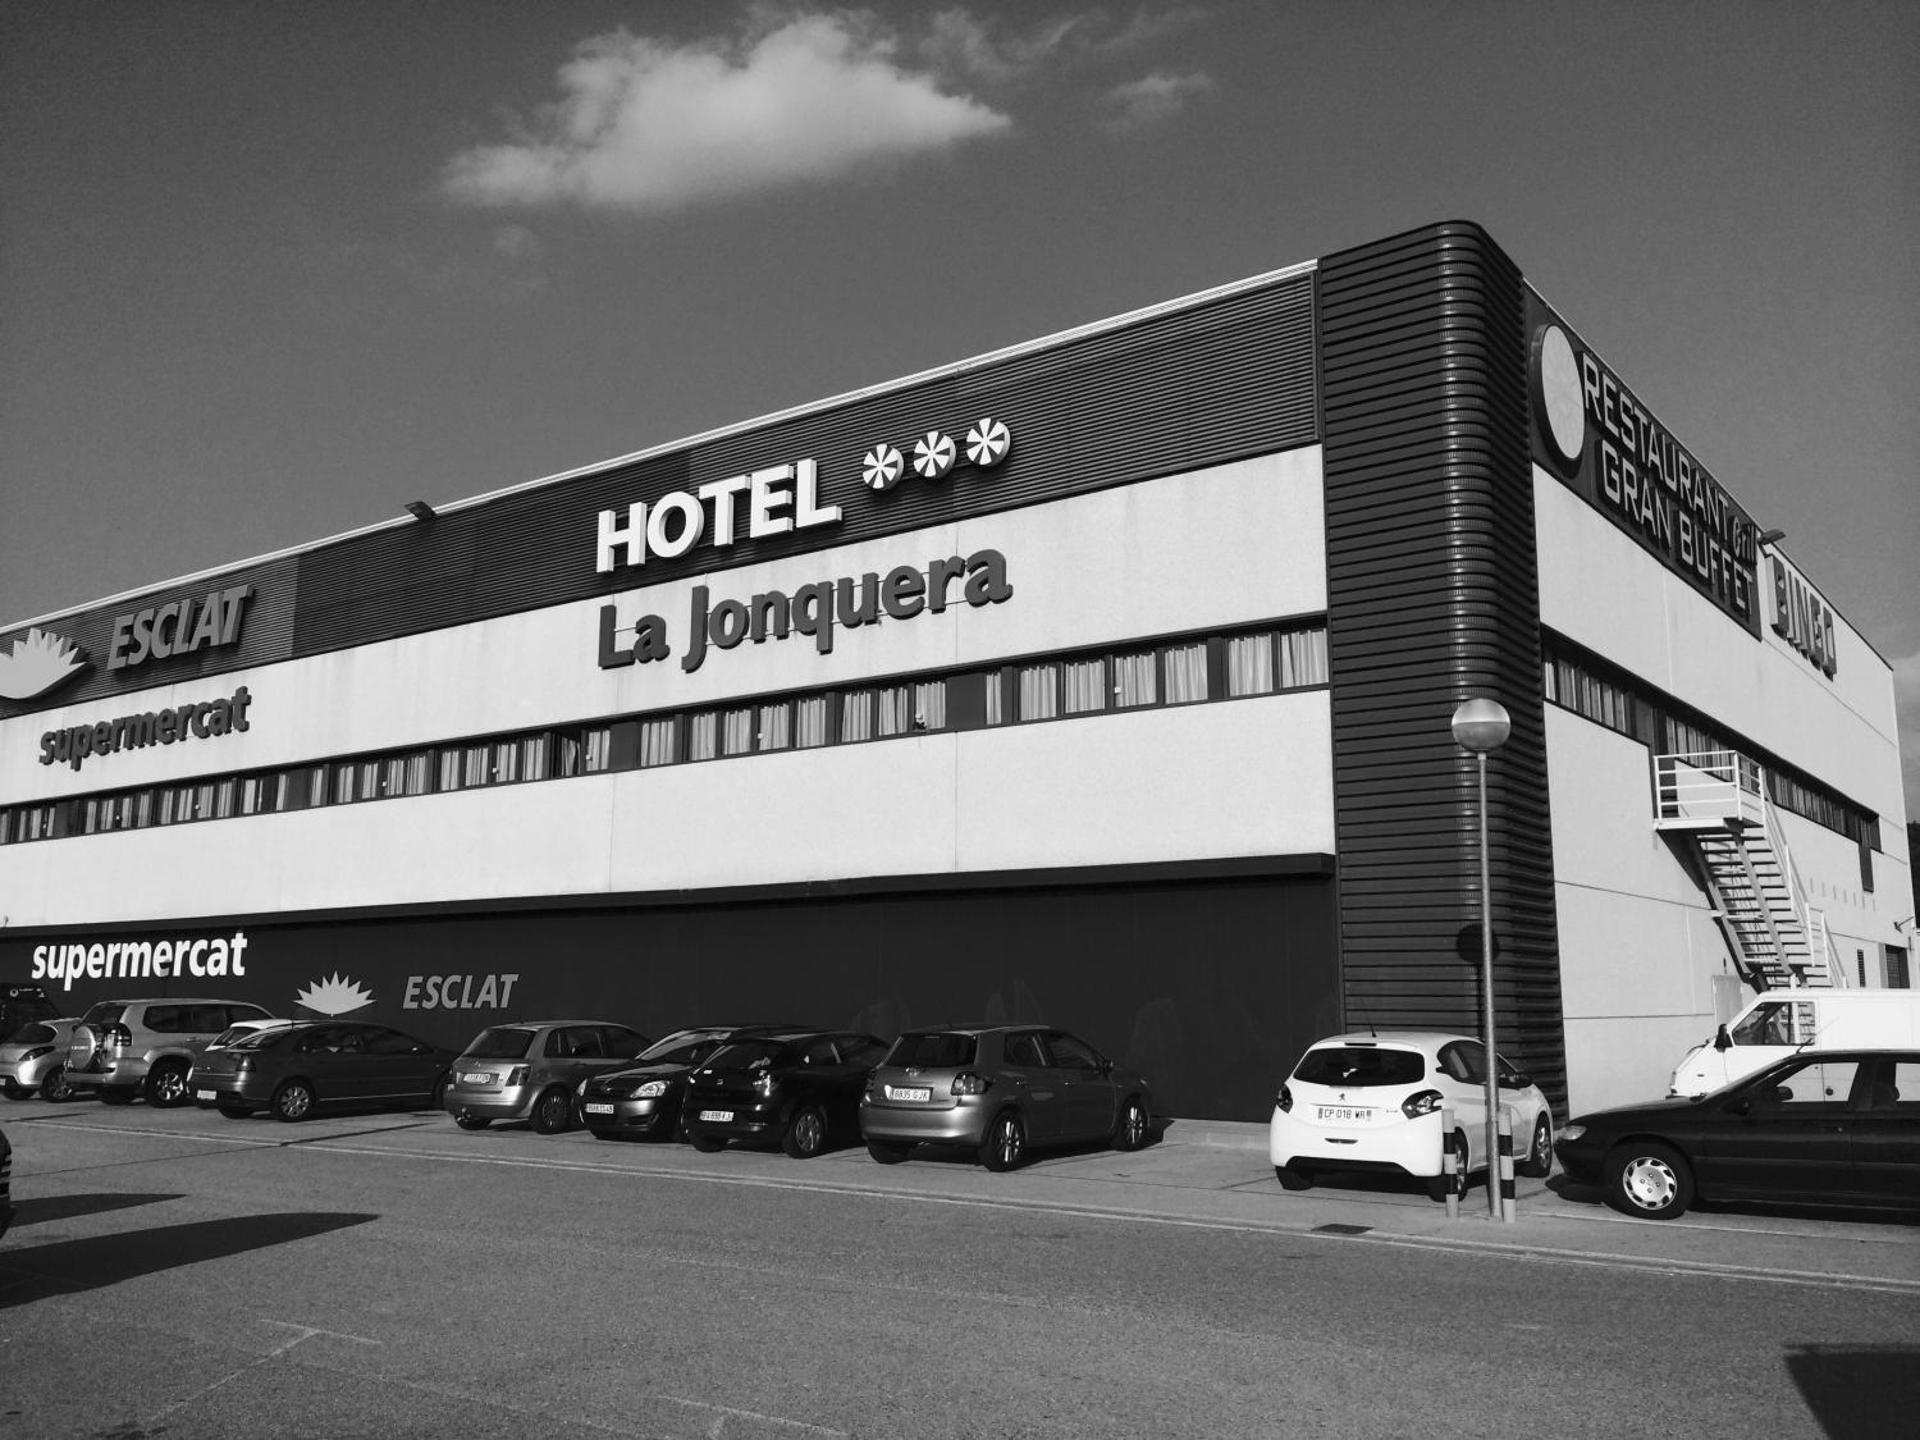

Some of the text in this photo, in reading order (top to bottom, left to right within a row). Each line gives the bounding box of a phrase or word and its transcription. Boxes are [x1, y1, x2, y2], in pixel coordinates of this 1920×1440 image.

[1582, 352, 1730, 542] RESTAURANT
[597, 457, 842, 573] HOTEL
[1602, 439, 1753, 617] GRAN BUFFET
[107, 584, 255, 671] ESCLAT
[598, 548, 1013, 673] La Jonquera
[39, 686, 252, 771] supermercat
[31, 931, 248, 992] supermercat
[403, 973, 519, 1011] ESCLAT
